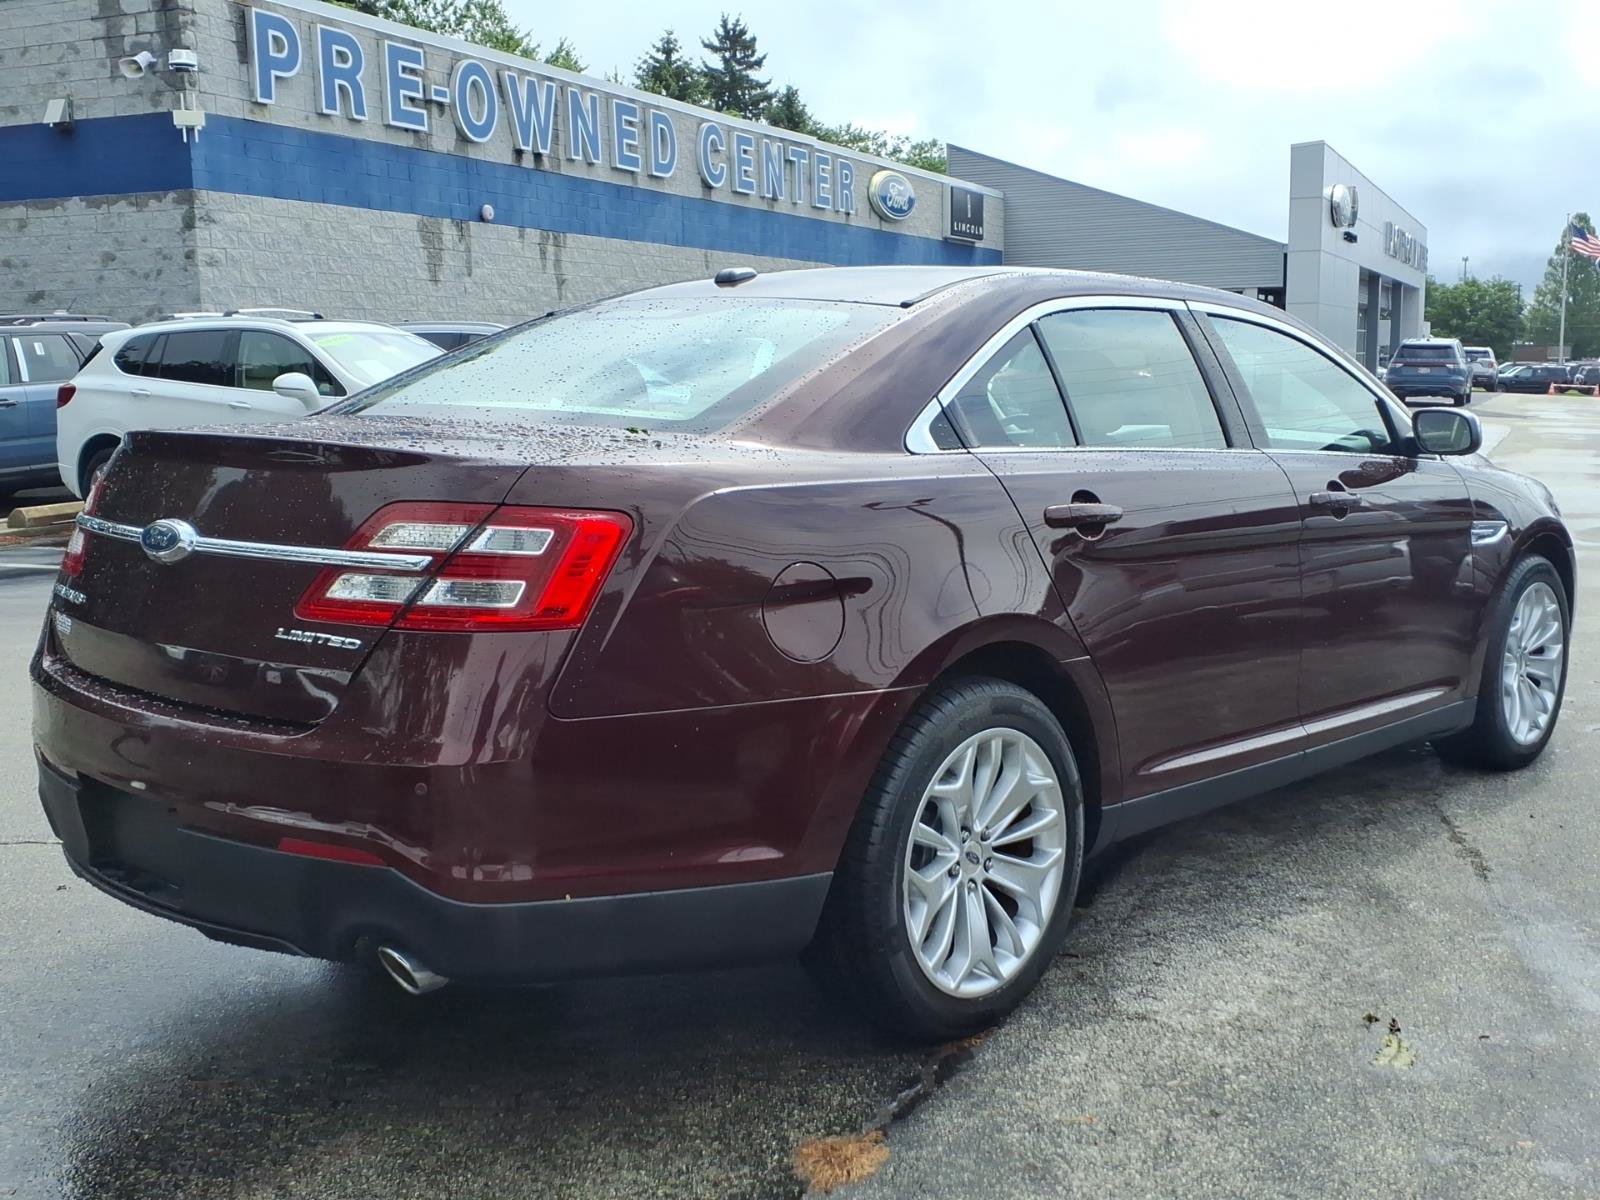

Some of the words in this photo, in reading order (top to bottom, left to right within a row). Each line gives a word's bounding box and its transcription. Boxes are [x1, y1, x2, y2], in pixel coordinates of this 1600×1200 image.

[251, 8, 677, 178] PRE-OWNED
[699, 121, 856, 213] CENTER
[886, 182, 910, 211] Ford
[953, 221, 984, 236] LINCOLN
[274, 627, 362, 650] LIMITED
